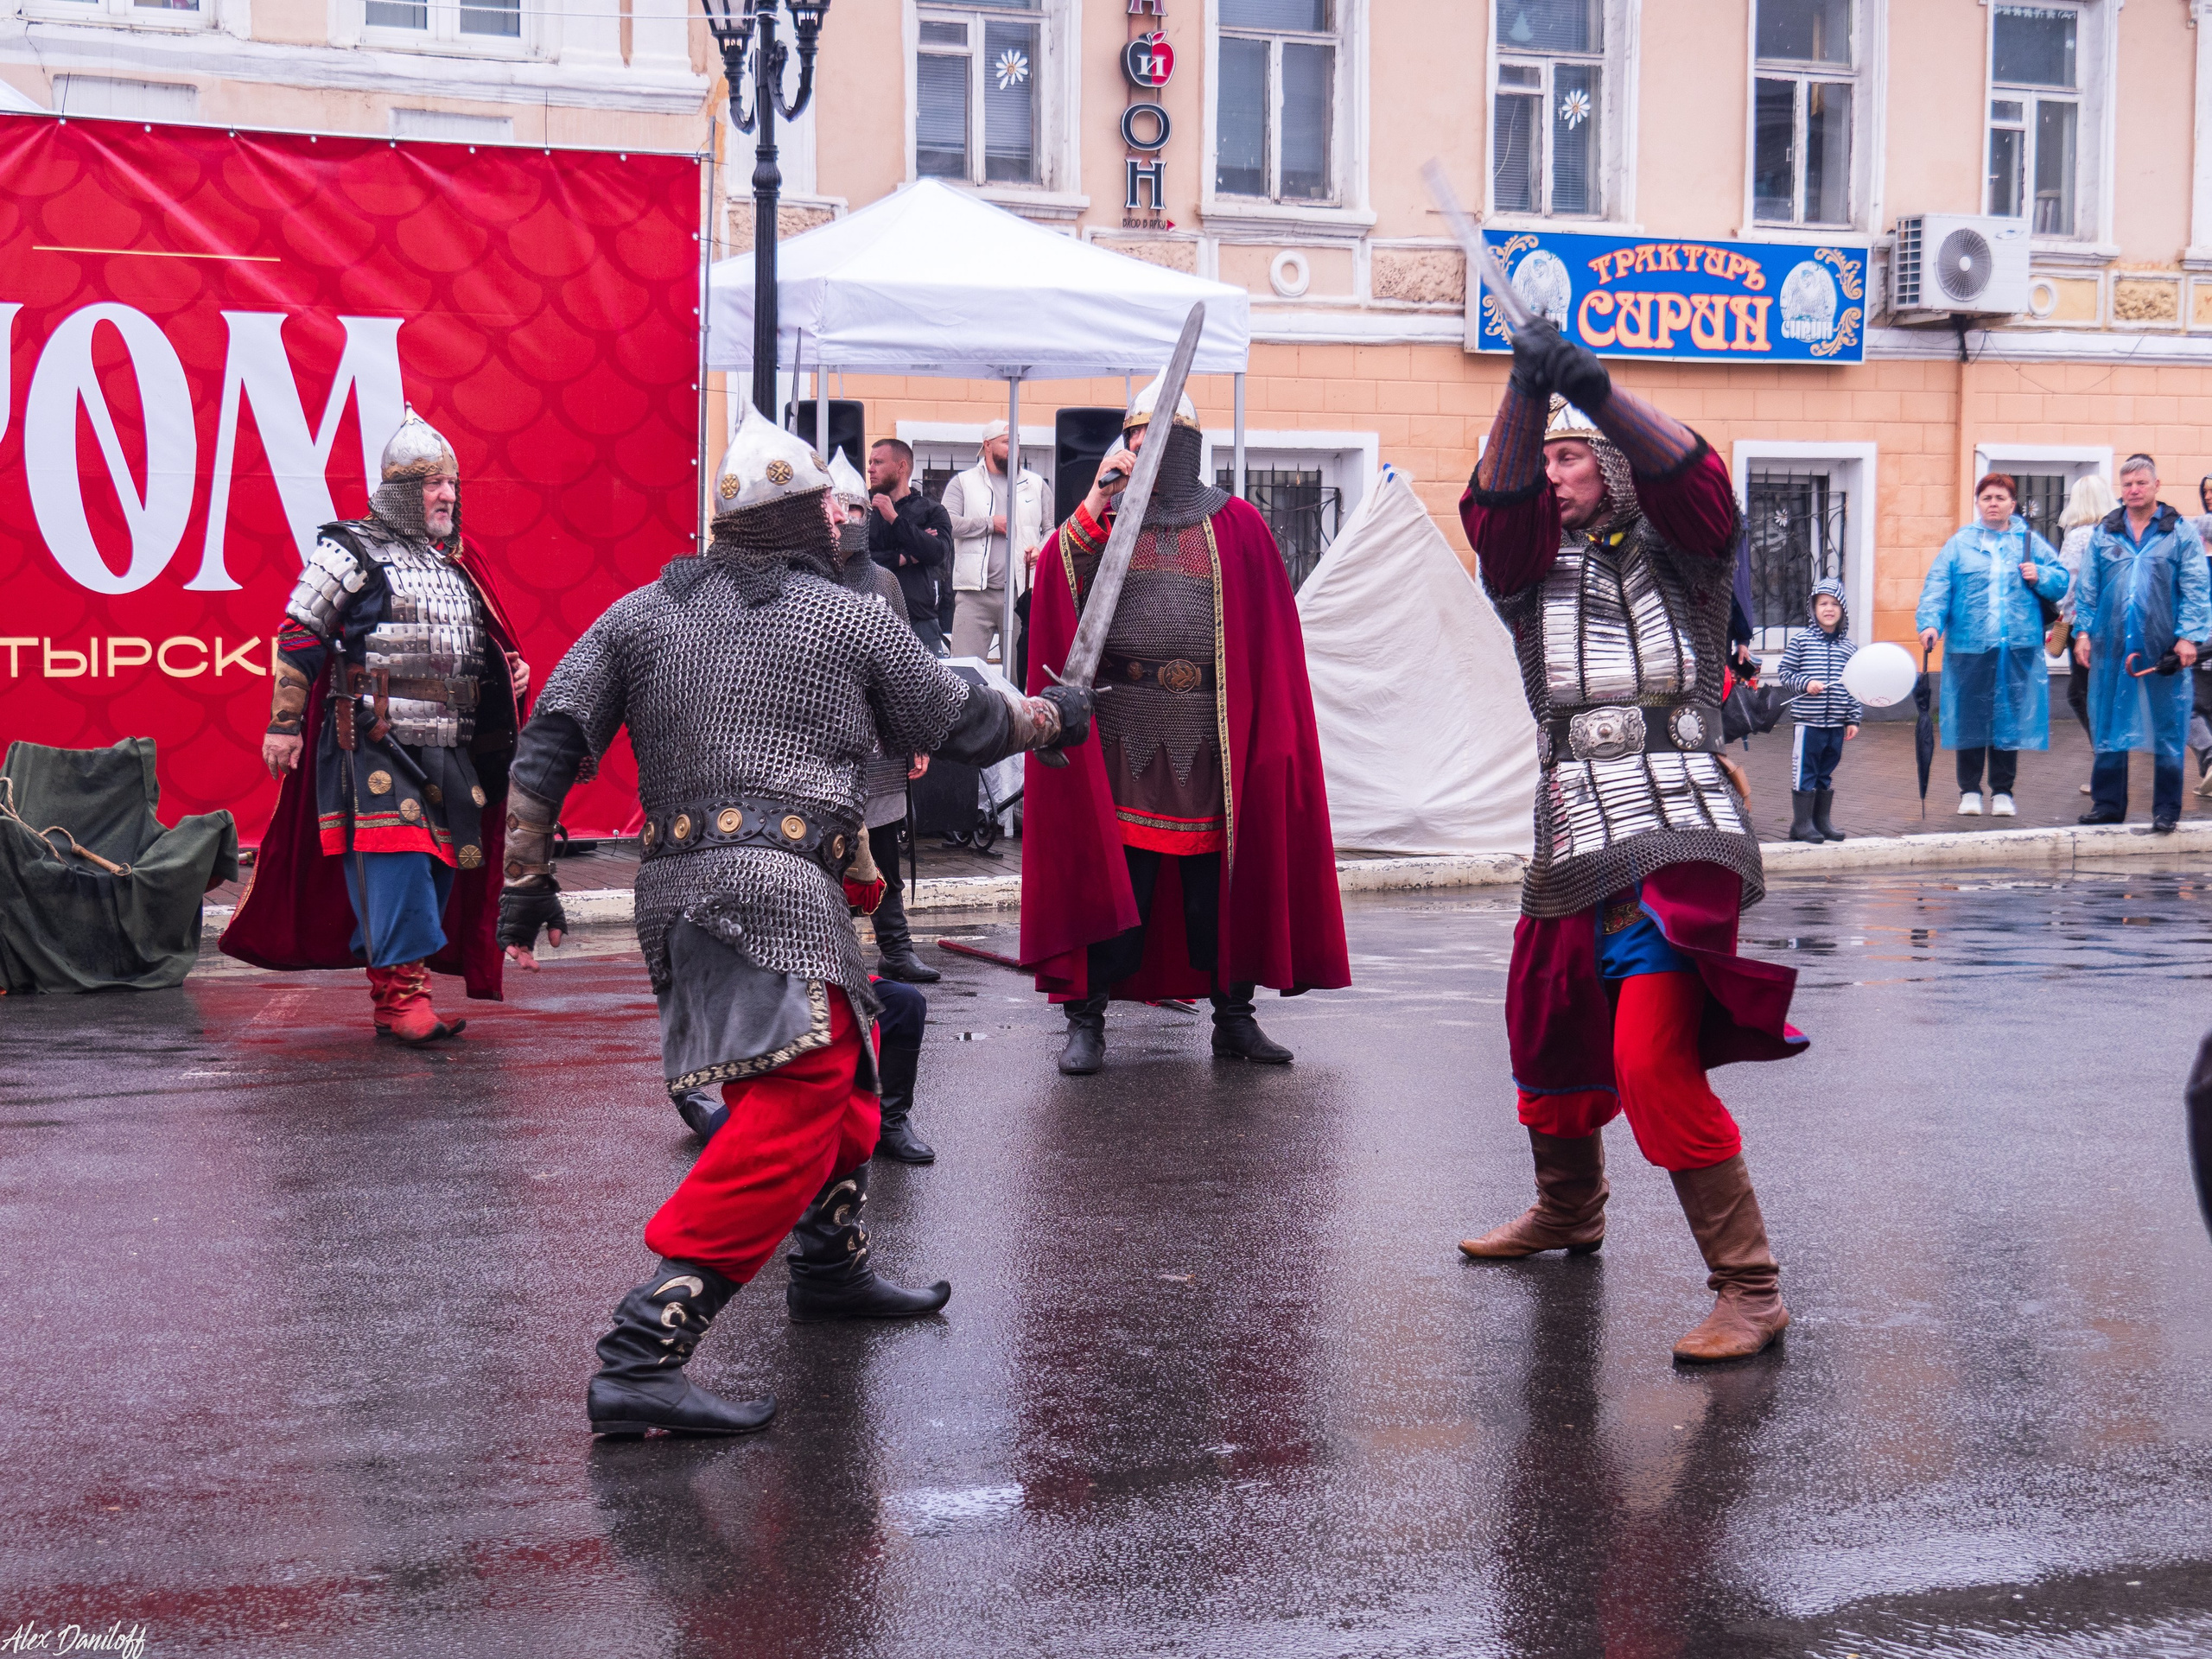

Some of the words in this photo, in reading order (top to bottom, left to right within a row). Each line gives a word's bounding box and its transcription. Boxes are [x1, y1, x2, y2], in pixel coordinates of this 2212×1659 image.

[1122, 217, 1141, 228] ВХОД
[1587, 243, 1767, 291] ТРАКТИРЪ
[1577, 289, 1774, 352] СИРИН
[1781, 320, 1834, 340] СИРИН
[0, 302, 405, 595] ОМ
